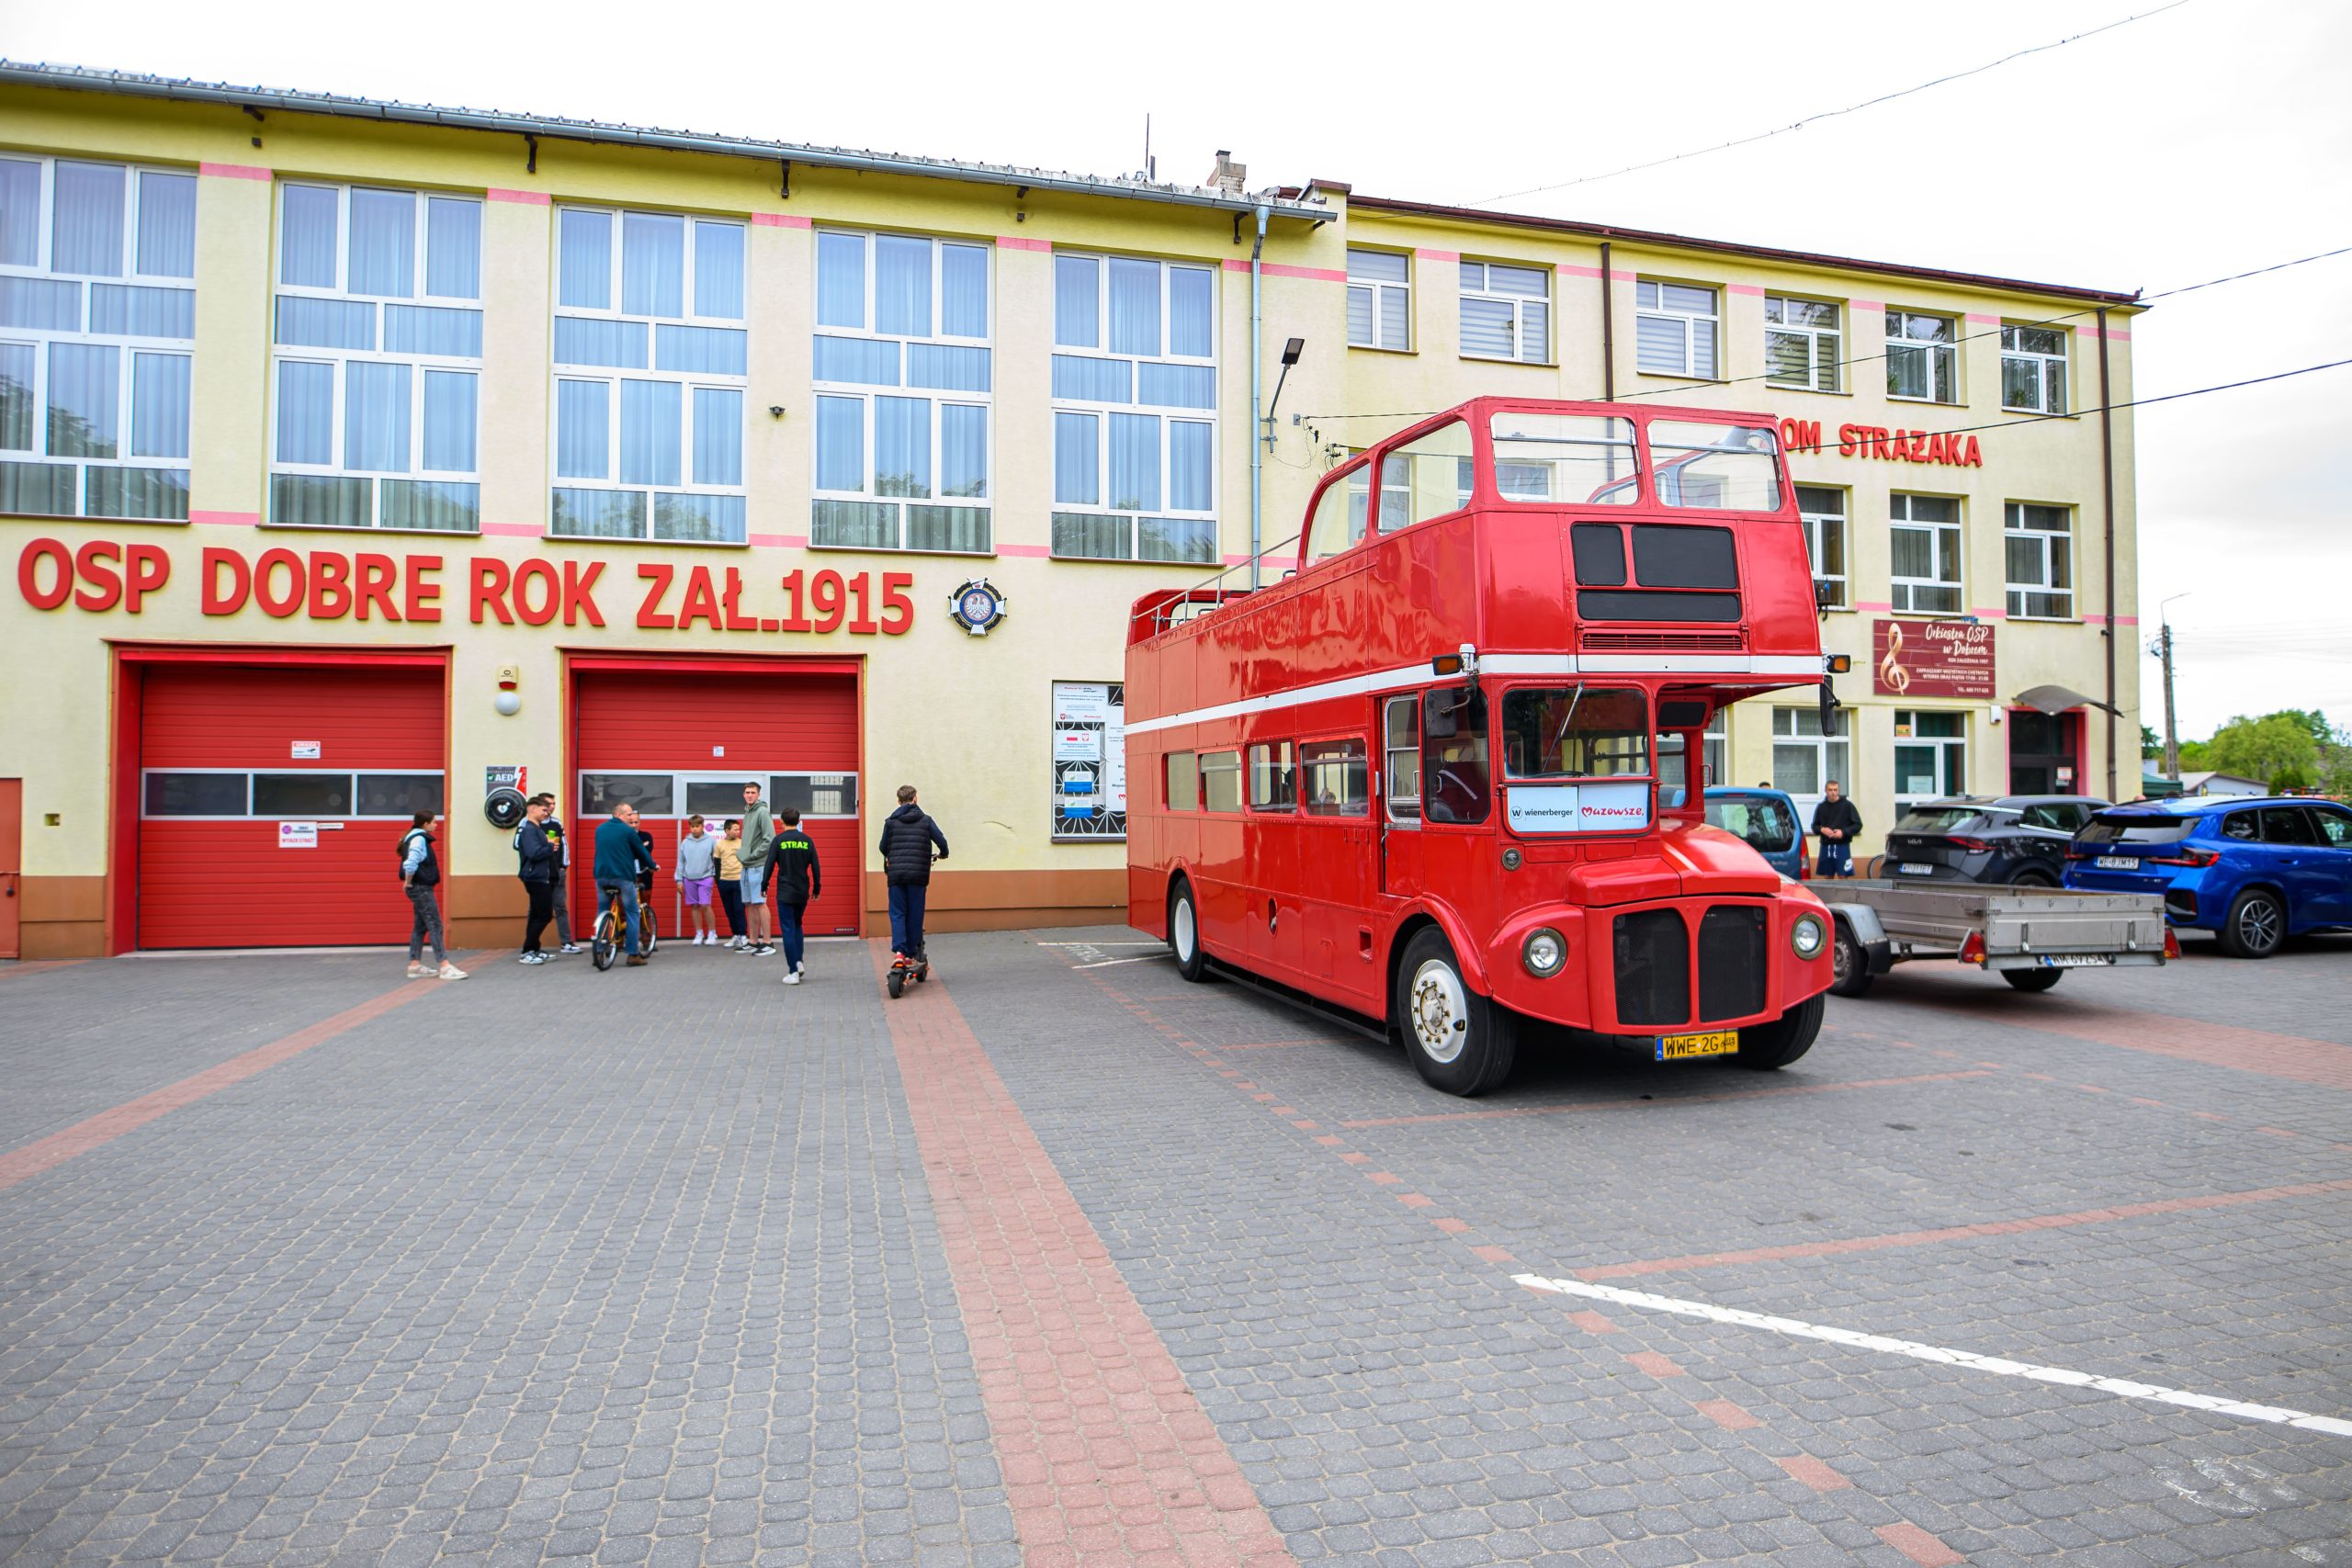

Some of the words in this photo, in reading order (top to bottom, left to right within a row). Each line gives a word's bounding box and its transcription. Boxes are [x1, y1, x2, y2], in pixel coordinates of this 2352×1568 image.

[1780, 417, 1821, 455] OM
[1838, 423, 1983, 468] STRAŻAKA
[17, 537, 171, 614] OSP
[201, 547, 444, 623] DOBRE
[469, 557, 606, 626] ROK
[1926, 624, 1964, 640] Orkiestra
[1966, 626, 1988, 642] OSP
[1943, 646, 1952, 654] w
[1953, 640, 1987, 656] Dobrem
[495, 773, 514, 782] AED
[1524, 808, 1573, 818] wienerberger
[1666, 1037, 1697, 1055] WWE
[1702, 1036, 1719, 1053] 2G
